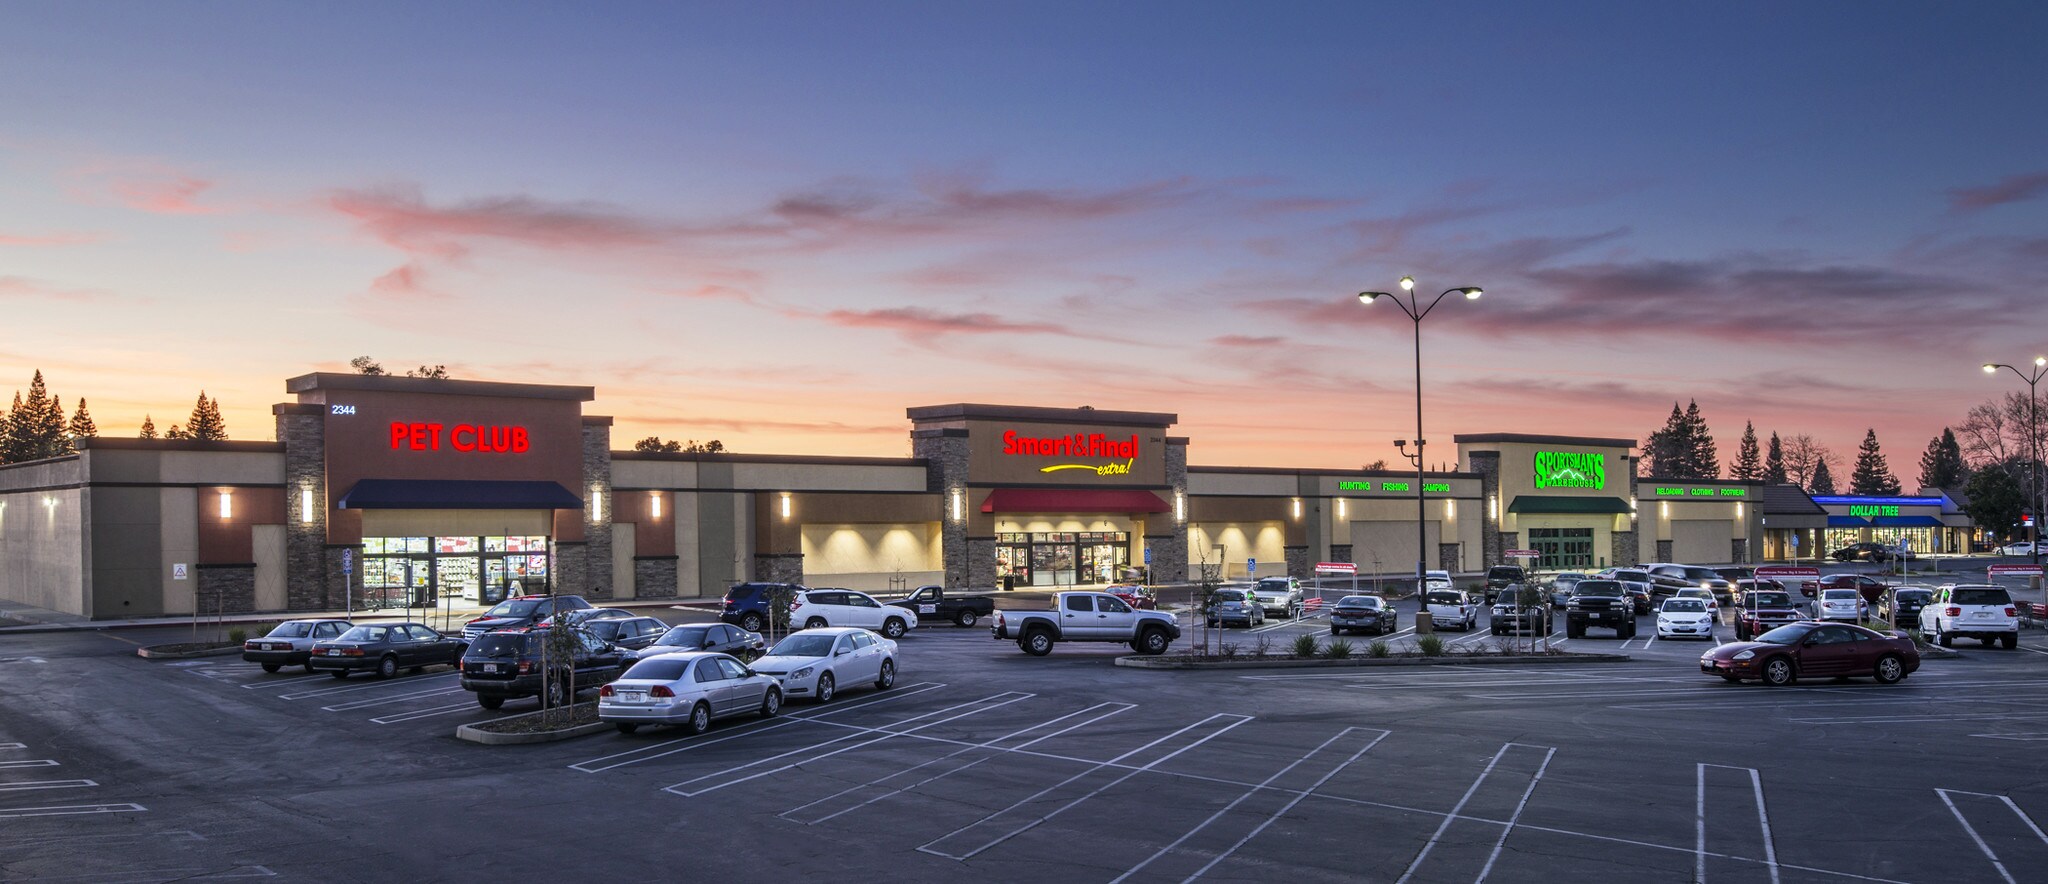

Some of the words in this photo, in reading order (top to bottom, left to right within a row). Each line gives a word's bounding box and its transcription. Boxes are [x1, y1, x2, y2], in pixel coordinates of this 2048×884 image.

[332, 405, 355, 415] 2344
[390, 421, 443, 451] PET
[450, 423, 530, 454] CLUB
[1003, 429, 1139, 459] Smart&Final
[1097, 457, 1133, 476] extra!
[1339, 481, 1371, 490] HUNTING
[1382, 482, 1409, 491] FISHING
[1546, 478, 1595, 488] WAREHOUSE
[1656, 487, 1684, 496] RELOADING
[1690, 488, 1714, 496] CLOTHING
[1720, 488, 1745, 496] FOOTWEAR
[1850, 505, 1879, 516] DOLLAR
[1881, 505, 1899, 516] TREE
